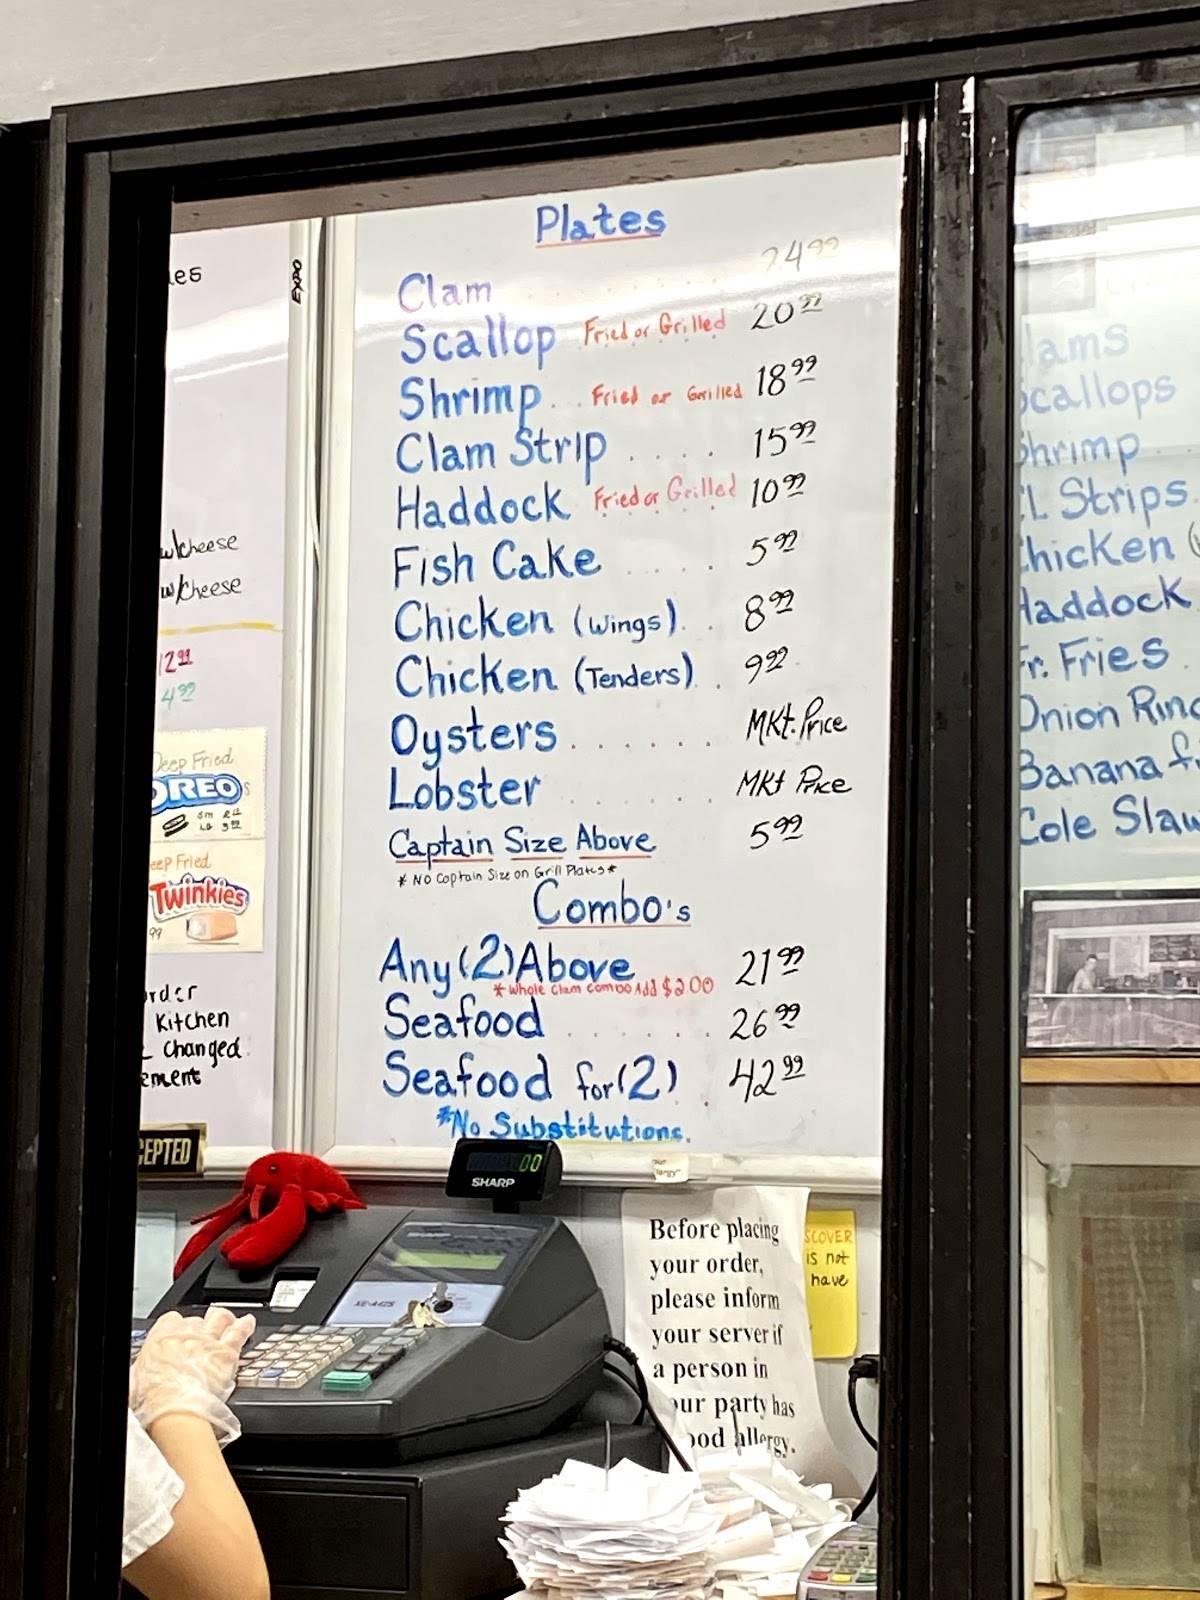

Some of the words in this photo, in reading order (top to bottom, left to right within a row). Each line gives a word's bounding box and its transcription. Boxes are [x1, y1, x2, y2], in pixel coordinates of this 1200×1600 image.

[535, 203, 667, 242] Plates
[398, 272, 492, 313] Clam
[401, 314, 556, 370] Scallop
[584, 320, 628, 346] Fried
[634, 325, 650, 339] or
[659, 312, 727, 336] Grilled
[400, 376, 541, 429] Shrimp
[591, 385, 638, 407] Fried
[651, 392, 672, 404] or
[687, 384, 743, 402] Grilled
[396, 432, 496, 474] Clam
[510, 426, 607, 485] Strip
[396, 481, 571, 530] Haddock
[594, 486, 639, 511] Fried
[644, 490, 658, 506] or
[667, 473, 737, 501] Grilled
[1060, 476, 1188, 529] Strips
[393, 543, 474, 590] Fish
[492, 538, 602, 580] Cake
[1021, 529, 1175, 573] hicken
[395, 595, 554, 642] Chicken
[395, 652, 558, 699] Chicken
[575, 651, 694, 695] (Tenders)
[1059, 637, 1169, 681] Fries
[390, 706, 558, 770] Oysters
[799, 696, 848, 744] Price
[192, 747, 234, 771] Fried
[1020, 749, 1163, 790] Banana
[389, 767, 541, 811] Lobster
[795, 764, 853, 795] Price
[1020, 805, 1096, 845] Cole
[150, 857, 171, 872] eep
[176, 852, 211, 869] Fried
[389, 826, 493, 869] Captain
[504, 826, 567, 856] Size
[576, 824, 657, 854] Above
[488, 869, 510, 881] Size
[515, 869, 529, 879] on
[534, 865, 561, 877] Grill
[150, 878, 244, 915] Twinkies
[533, 878, 691, 926] Combo's
[379, 937, 450, 999] Any
[516, 940, 636, 984] Above
[145, 984, 197, 1003] rder
[551, 984, 581, 995] Clam
[384, 992, 544, 1040] Seafood
[382, 1051, 553, 1100] Seafood
[576, 1061, 613, 1100] for
[472, 1177, 515, 1188] SHARP
[650, 1218, 720, 1240] Before
[727, 1217, 779, 1246] placing
[650, 1256, 699, 1280] your
[706, 1252, 764, 1276] order,
[826, 1251, 850, 1265] not
[812, 1273, 848, 1286] have
[651, 1288, 716, 1315] please
[724, 1287, 779, 1310] inform
[652, 1327, 701, 1349] your
[709, 1325, 768, 1344] server
[772, 1324, 783, 1345] if
[653, 1362, 664, 1378] a
[673, 1361, 747, 1384] person
[754, 1357, 768, 1379] in
[715, 1394, 766, 1420] party
[772, 1394, 795, 1418] has
